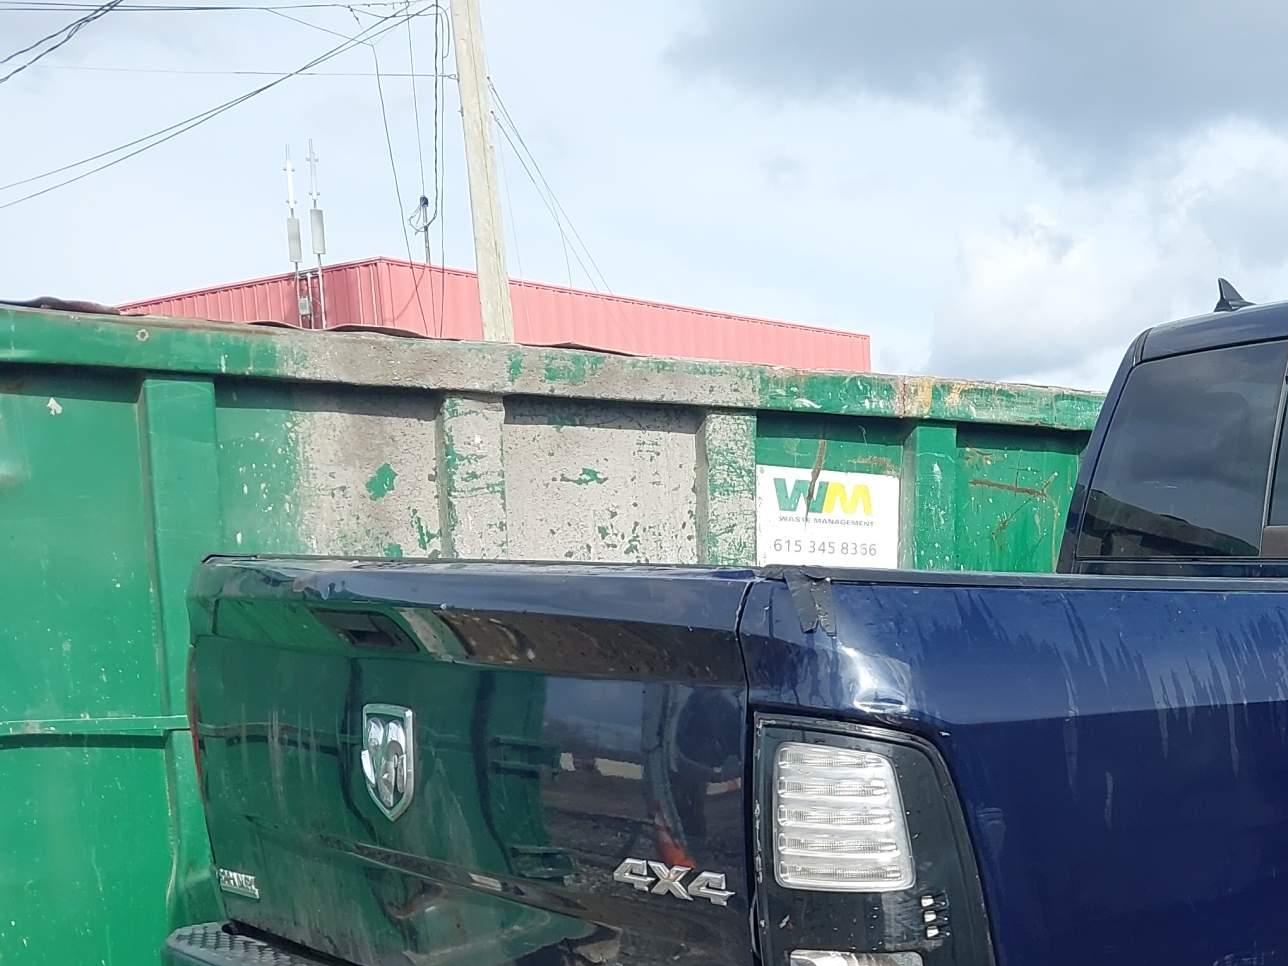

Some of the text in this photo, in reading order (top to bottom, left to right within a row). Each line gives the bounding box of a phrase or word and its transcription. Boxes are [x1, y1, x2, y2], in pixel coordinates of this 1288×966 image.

[774, 478, 872, 515] WM
[814, 518, 873, 526] MANAGEMENT
[773, 538, 803, 553] 615
[808, 541, 836, 555] 345
